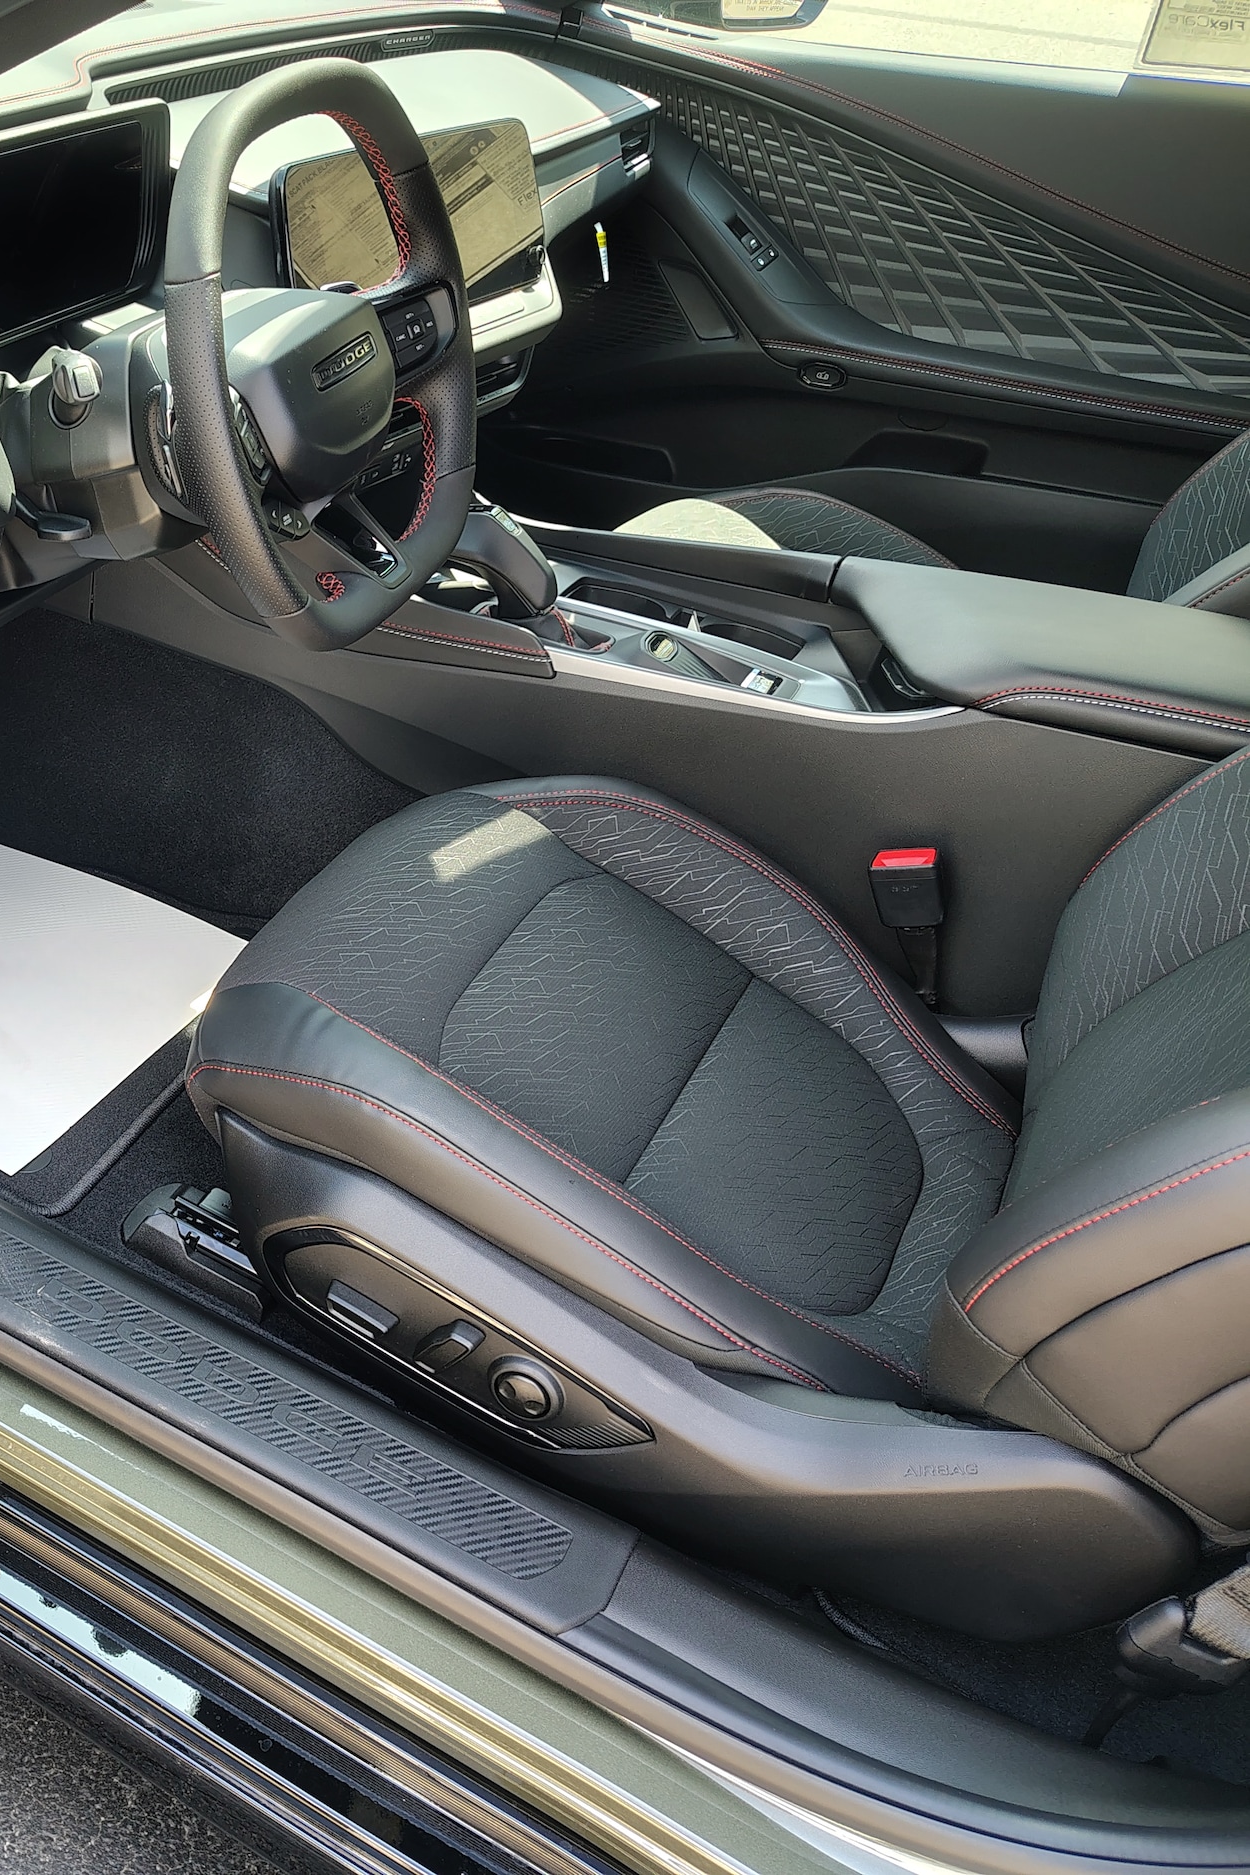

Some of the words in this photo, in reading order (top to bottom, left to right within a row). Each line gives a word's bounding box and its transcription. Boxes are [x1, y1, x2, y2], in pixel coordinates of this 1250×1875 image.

[386, 35, 431, 45] CHARGER
[320, 340, 373, 382] DODGE
[36, 1275, 429, 1498] DODGE
[903, 1463, 979, 1478] AIRBAG
